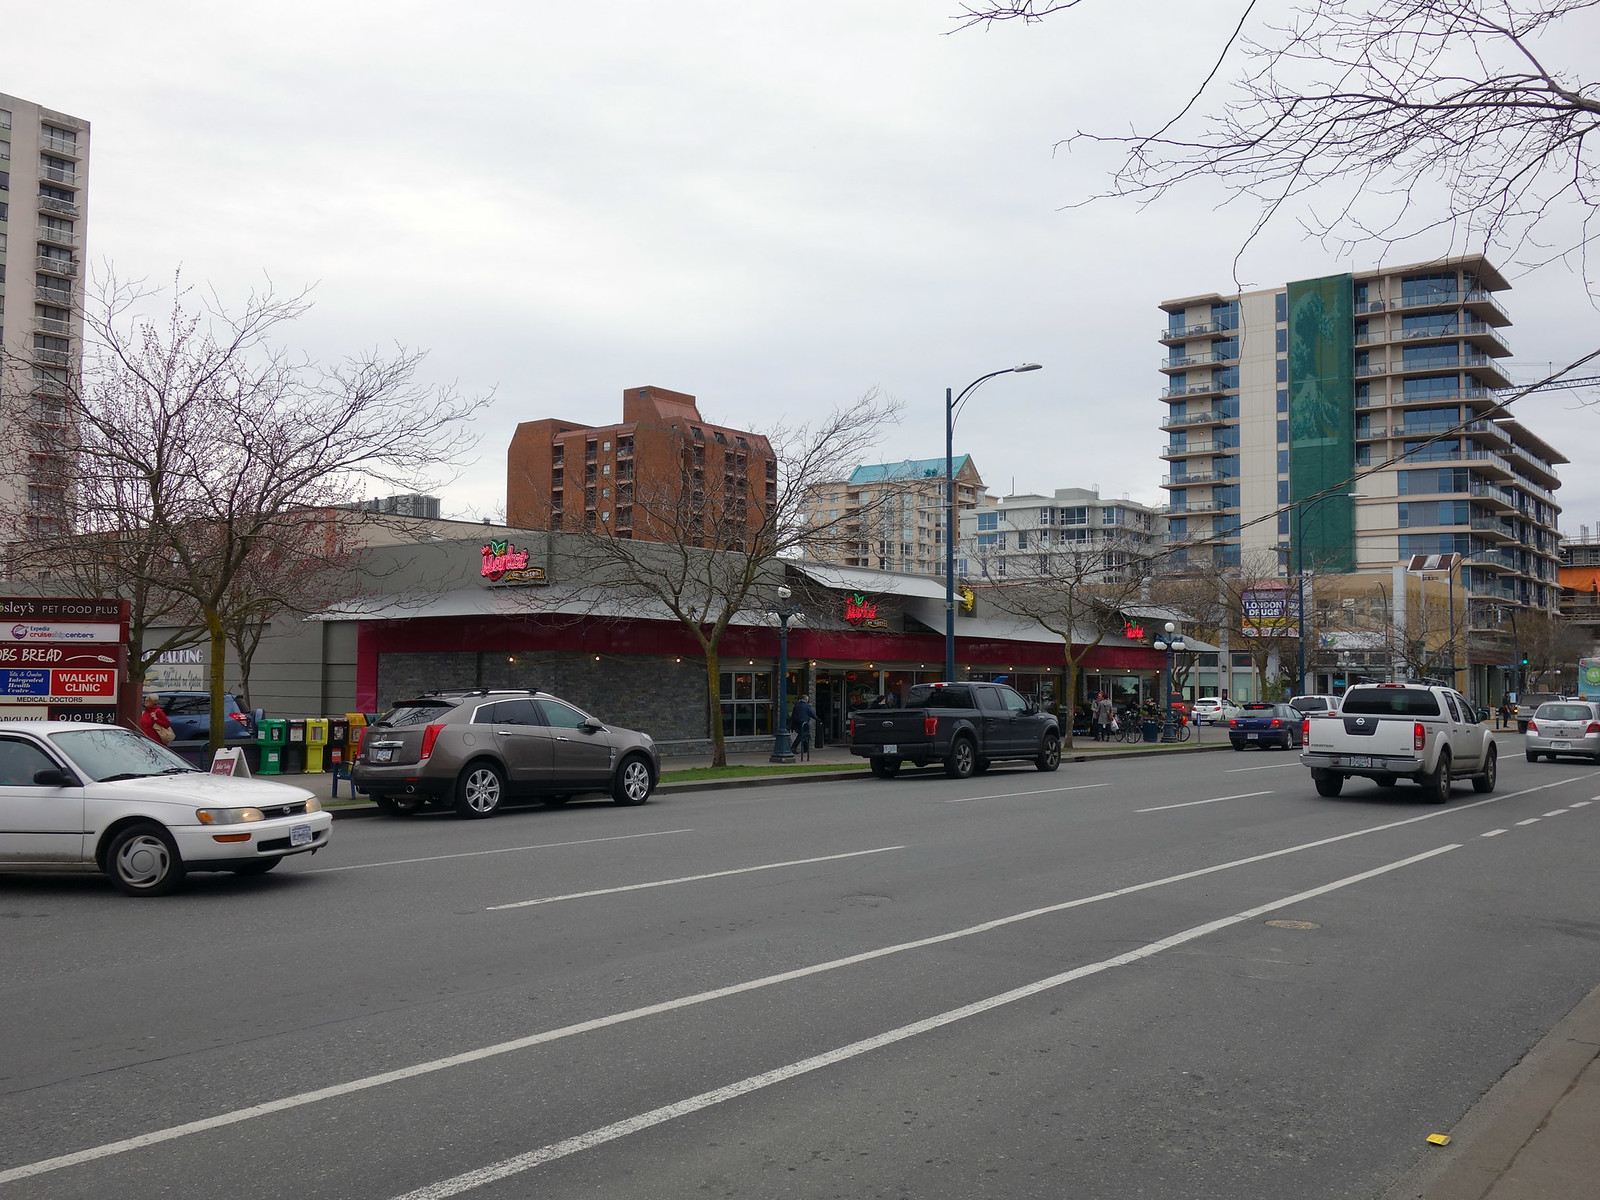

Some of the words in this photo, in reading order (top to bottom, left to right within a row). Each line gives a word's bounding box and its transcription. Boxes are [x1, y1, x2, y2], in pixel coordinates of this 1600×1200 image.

[42, 605, 58, 613] PET
[62, 605, 92, 614] FOOD
[95, 606, 118, 615] PLUS
[1246, 601, 1282, 609] LONDON
[21, 648, 63, 662] BREAD
[159, 650, 204, 663] PARKING
[59, 673, 108, 683] WALK-IN
[65, 683, 101, 692] CLINIC
[85, 712, 115, 723] 미용실
